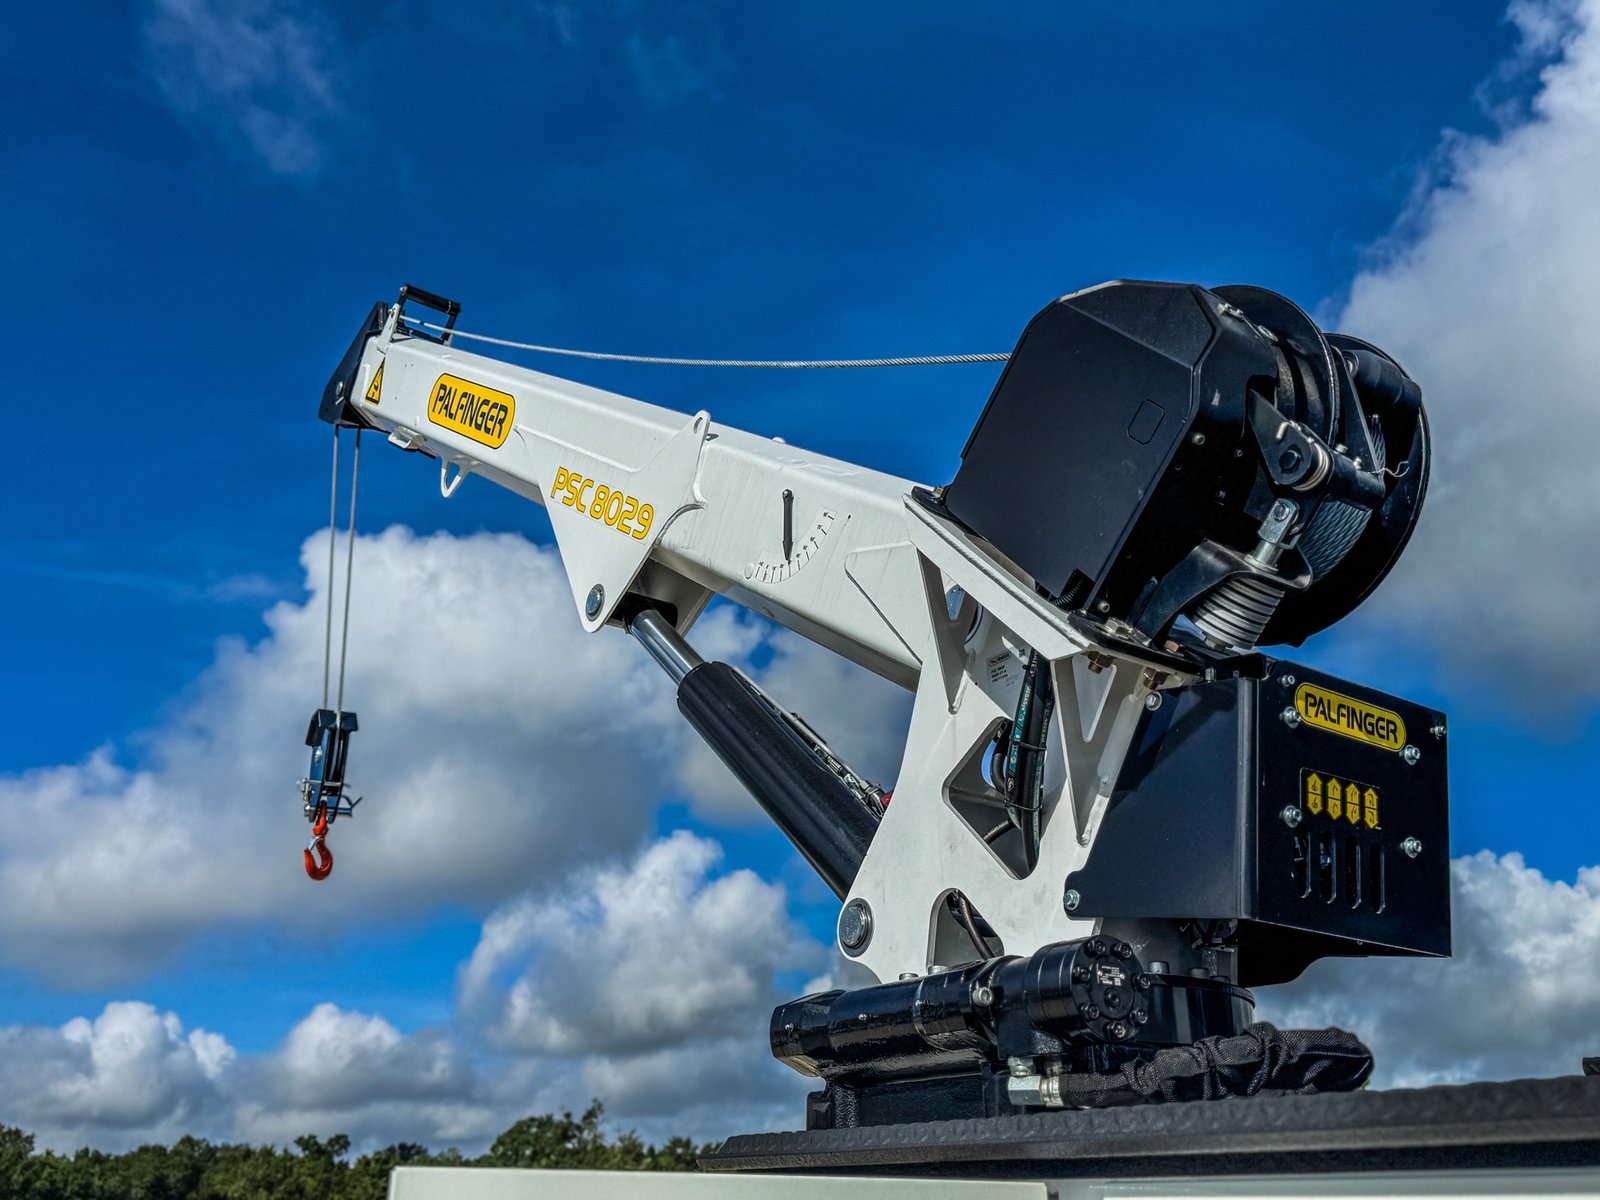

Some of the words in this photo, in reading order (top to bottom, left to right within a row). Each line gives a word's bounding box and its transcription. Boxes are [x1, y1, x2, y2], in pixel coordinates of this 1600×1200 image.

[432, 383, 508, 440] PALFINGER
[551, 466, 595, 513] PSC
[589, 485, 655, 541] 8029
[1305, 691, 1398, 744] PALFINGER
